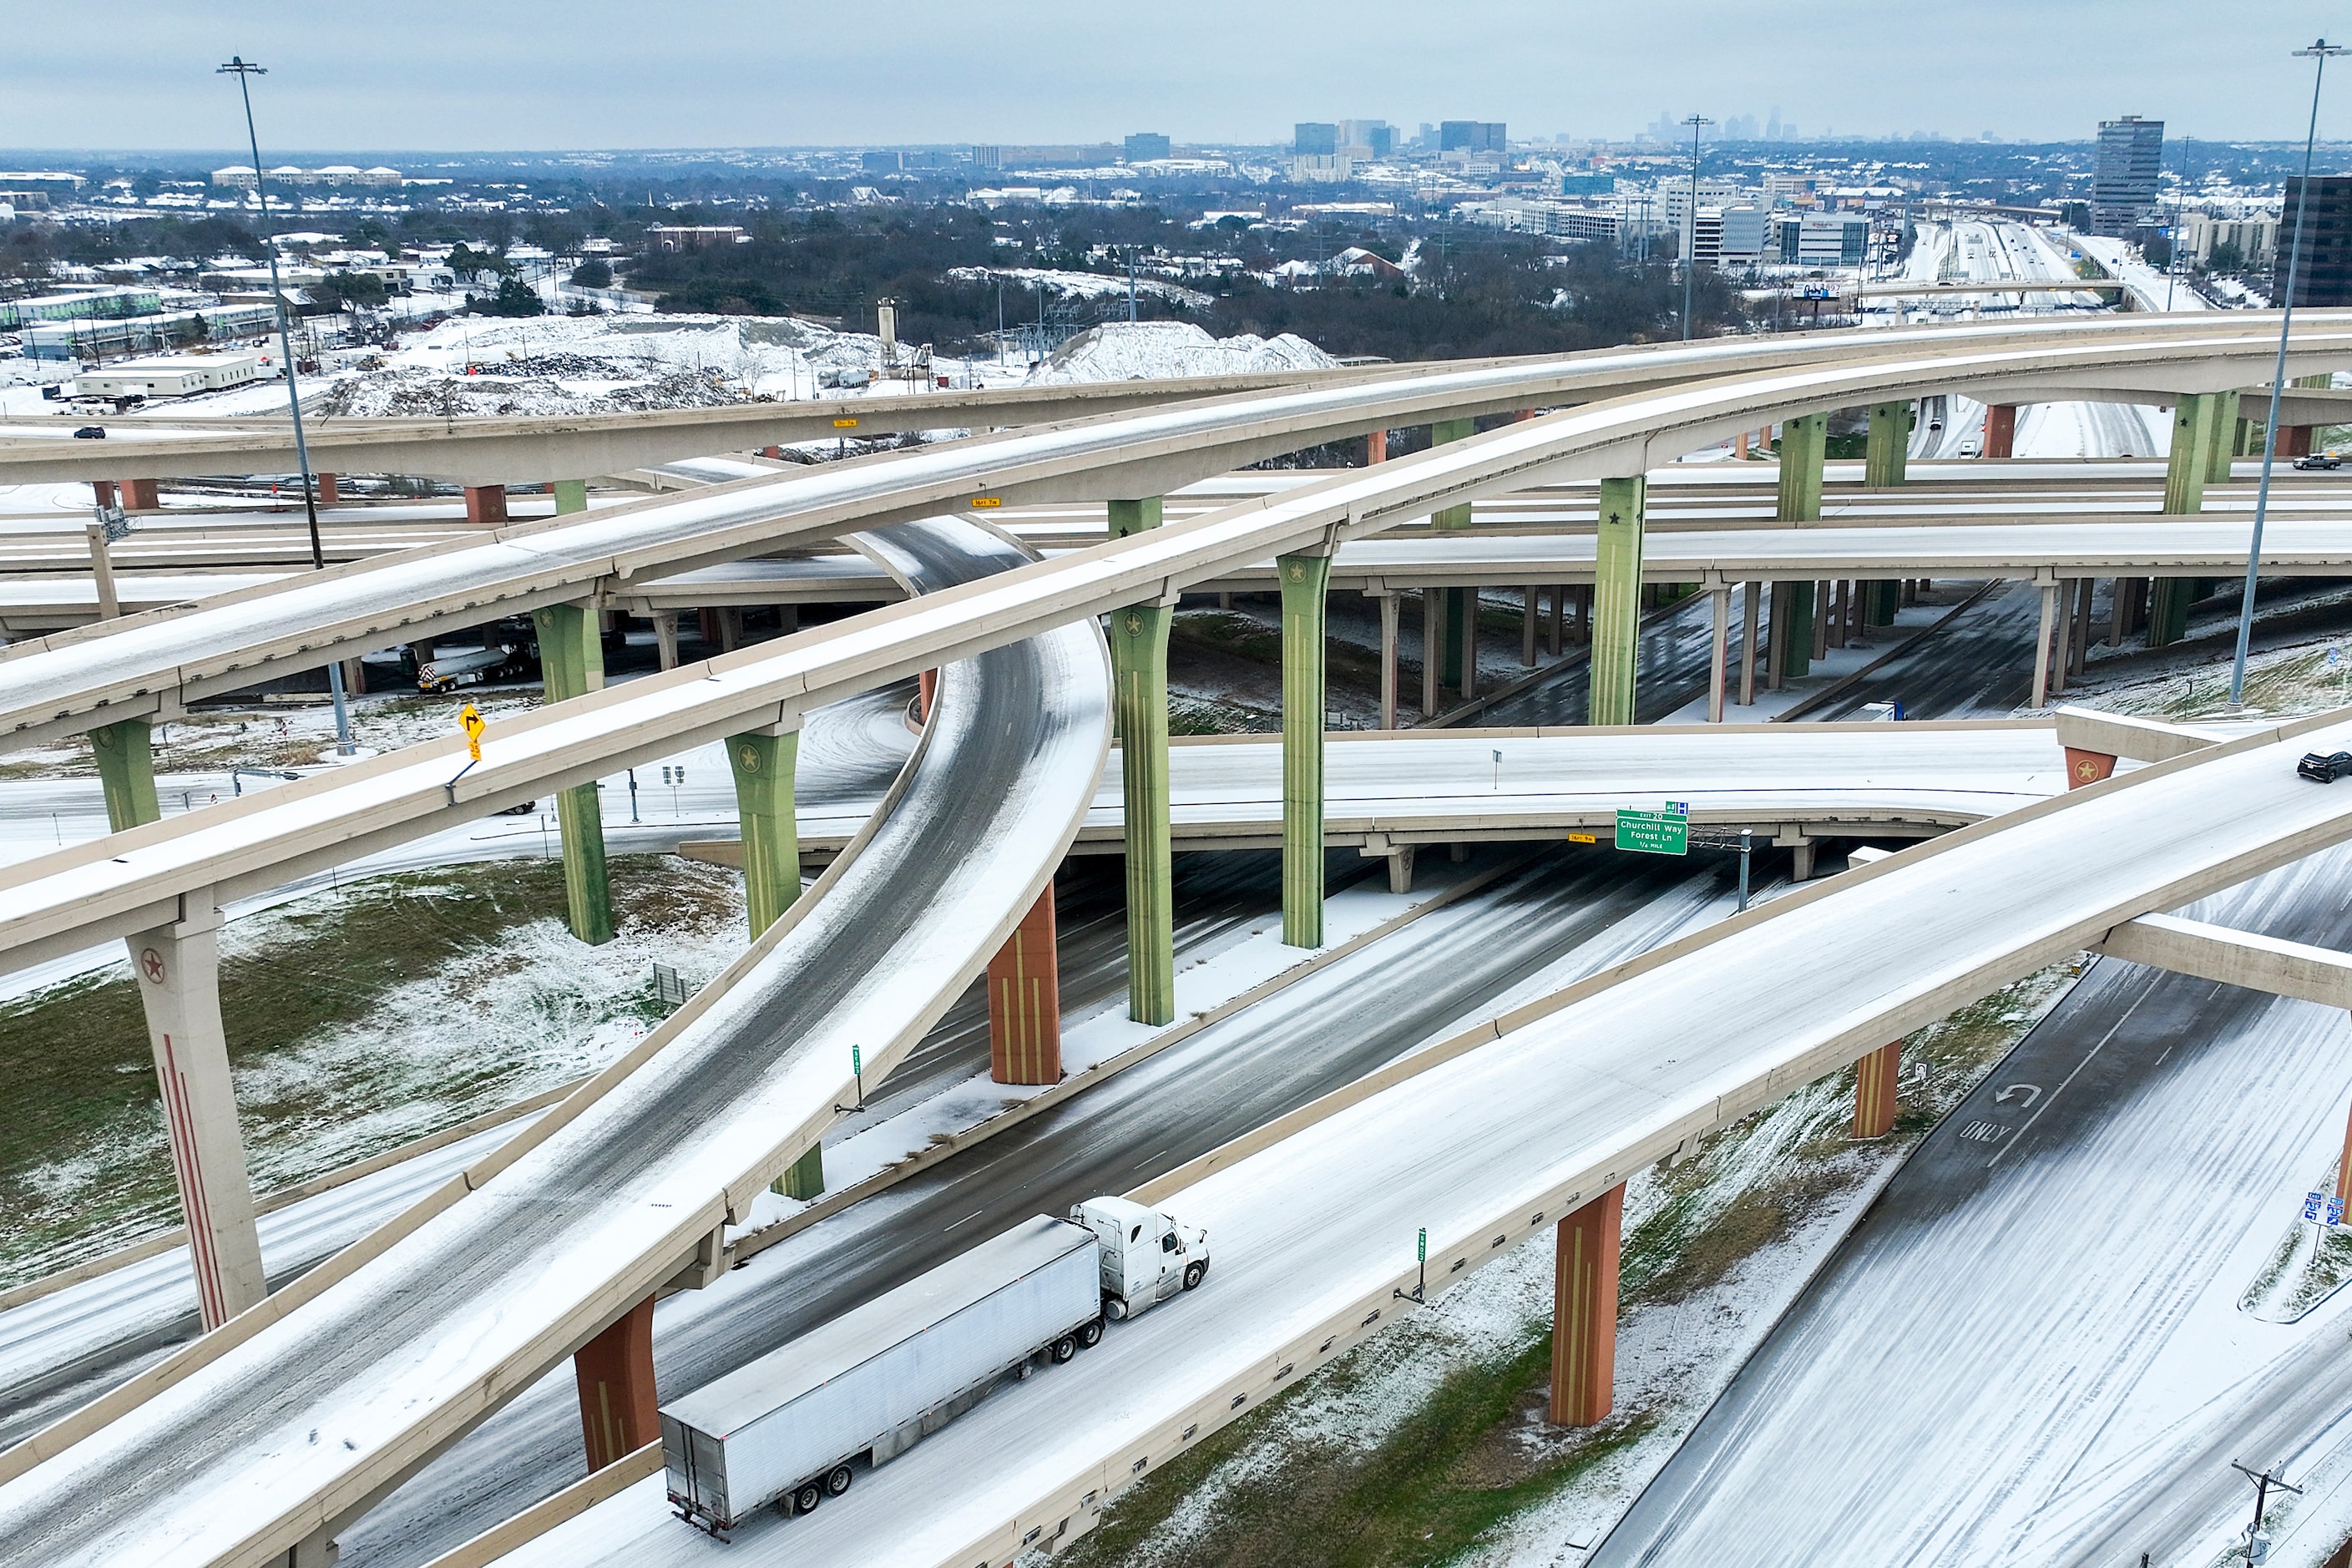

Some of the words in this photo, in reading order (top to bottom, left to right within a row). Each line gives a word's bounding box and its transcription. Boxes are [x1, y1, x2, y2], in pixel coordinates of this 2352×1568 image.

[470, 744, 479, 753] 35
[1677, 802, 1687, 814] H
[1621, 821, 1661, 832] Churchill
[1664, 825, 1682, 835] Way
[1631, 831, 1658, 841] Forest
[1959, 1120, 2011, 1143] ONLY
[2306, 1202, 2320, 1211] 635
[2329, 1207, 2342, 1216] 635
